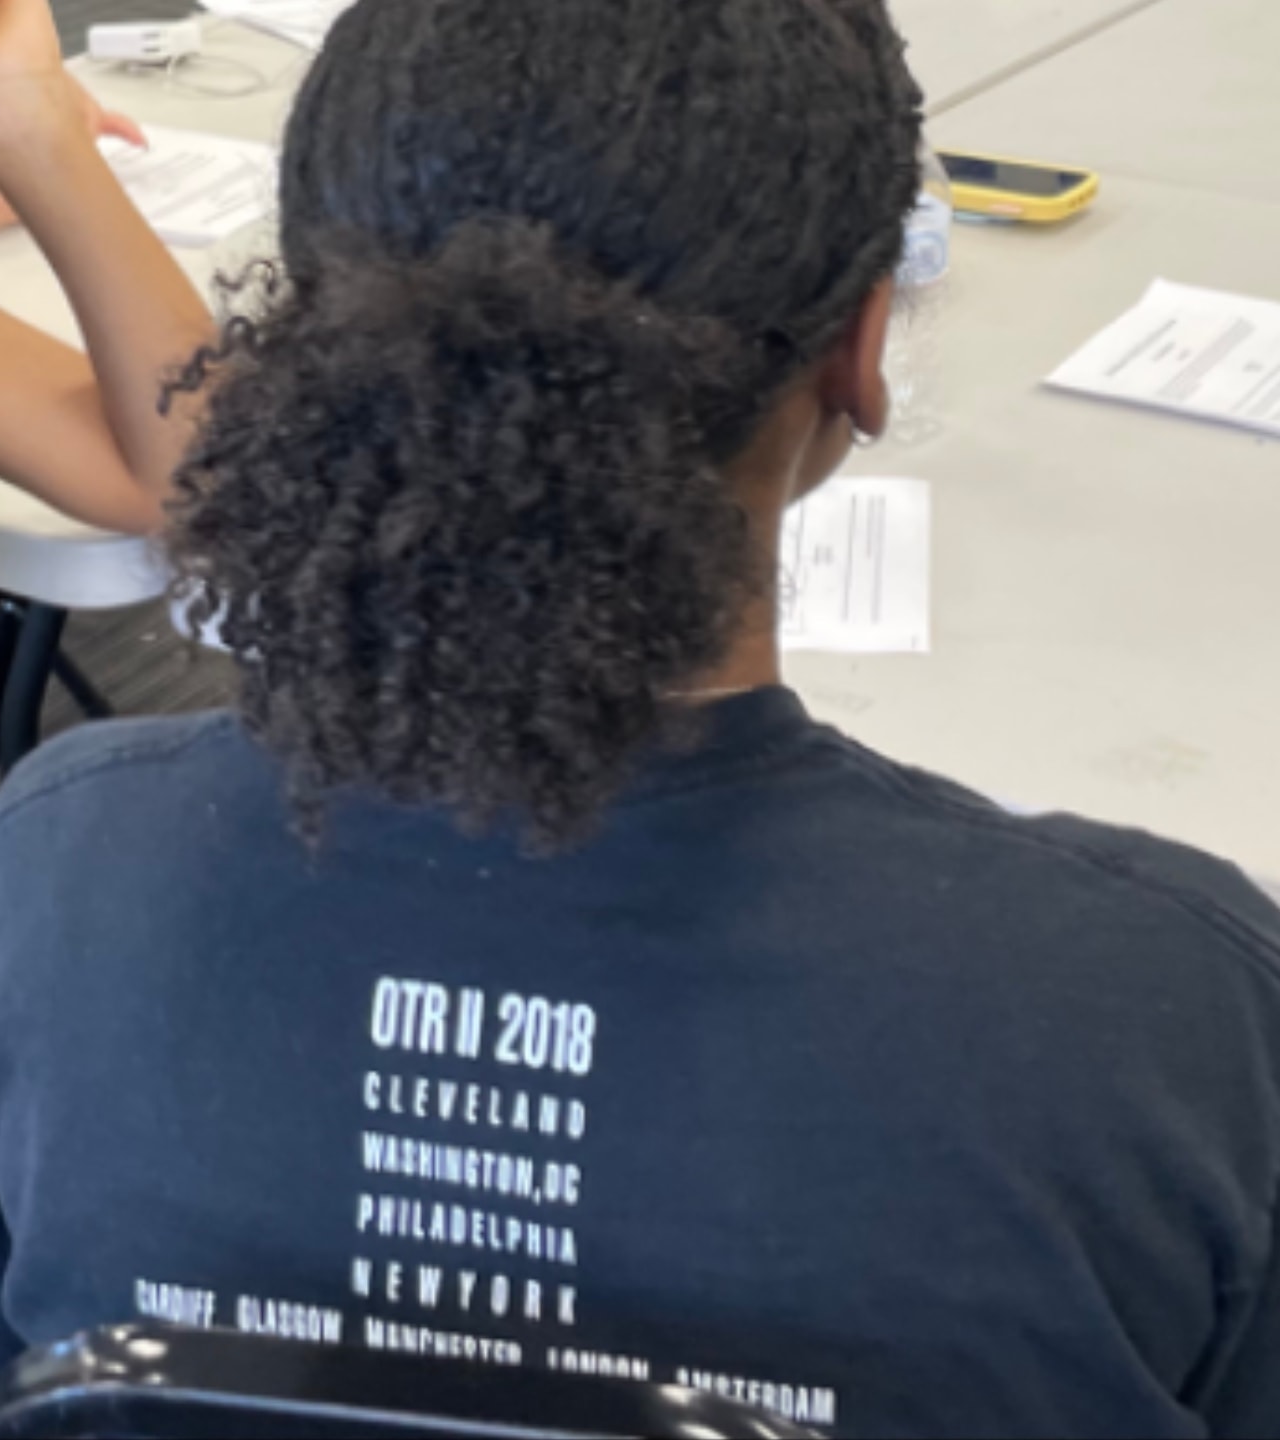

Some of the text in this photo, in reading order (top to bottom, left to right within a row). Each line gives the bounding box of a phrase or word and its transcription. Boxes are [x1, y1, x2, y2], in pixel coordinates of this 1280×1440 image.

[370, 974, 597, 1076] OTR II 2018
[363, 1069, 587, 1140] CLEVELAND
[356, 1192, 578, 1267] PHILADELPHIA
[134, 1277, 217, 1330] CARDIFF
[235, 1293, 343, 1344] GLASGOW
